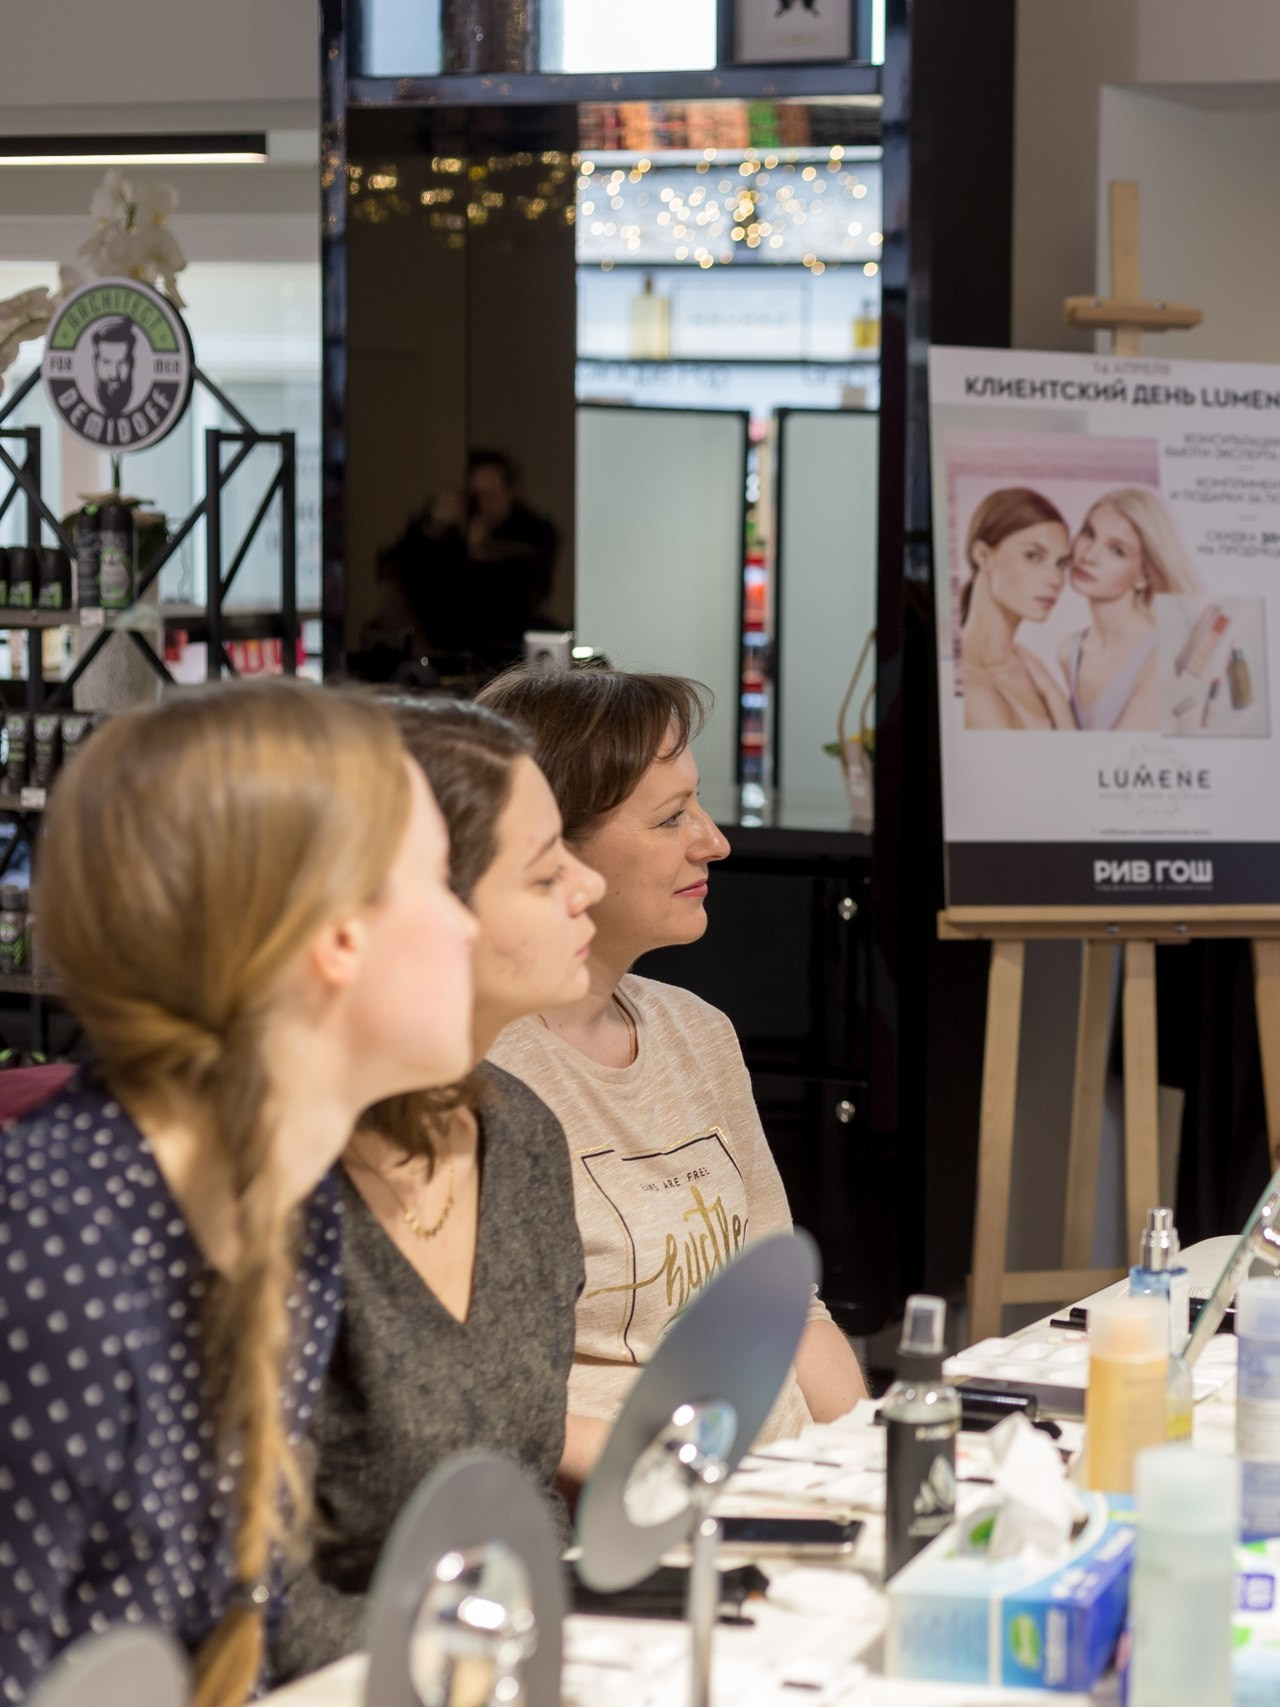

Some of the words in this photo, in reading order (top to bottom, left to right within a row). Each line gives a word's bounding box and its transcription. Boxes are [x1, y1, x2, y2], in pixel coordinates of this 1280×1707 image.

[66, 287, 163, 330] ARCHITECT
[50, 358, 73, 371] FOR
[153, 358, 180, 374] MEN
[1114, 362, 1170, 376] АПРЕЛЯ
[965, 376, 1127, 402] КЛИЕНТСКИЙ
[1132, 383, 1196, 407] ДЕНЬ
[57, 387, 171, 444] DEMIDOFF
[1098, 764, 1212, 789] LUMENE
[1094, 859, 1151, 884] РИВ
[1155, 859, 1214, 884] ГОШ
[663, 1177, 681, 1190] ARE
